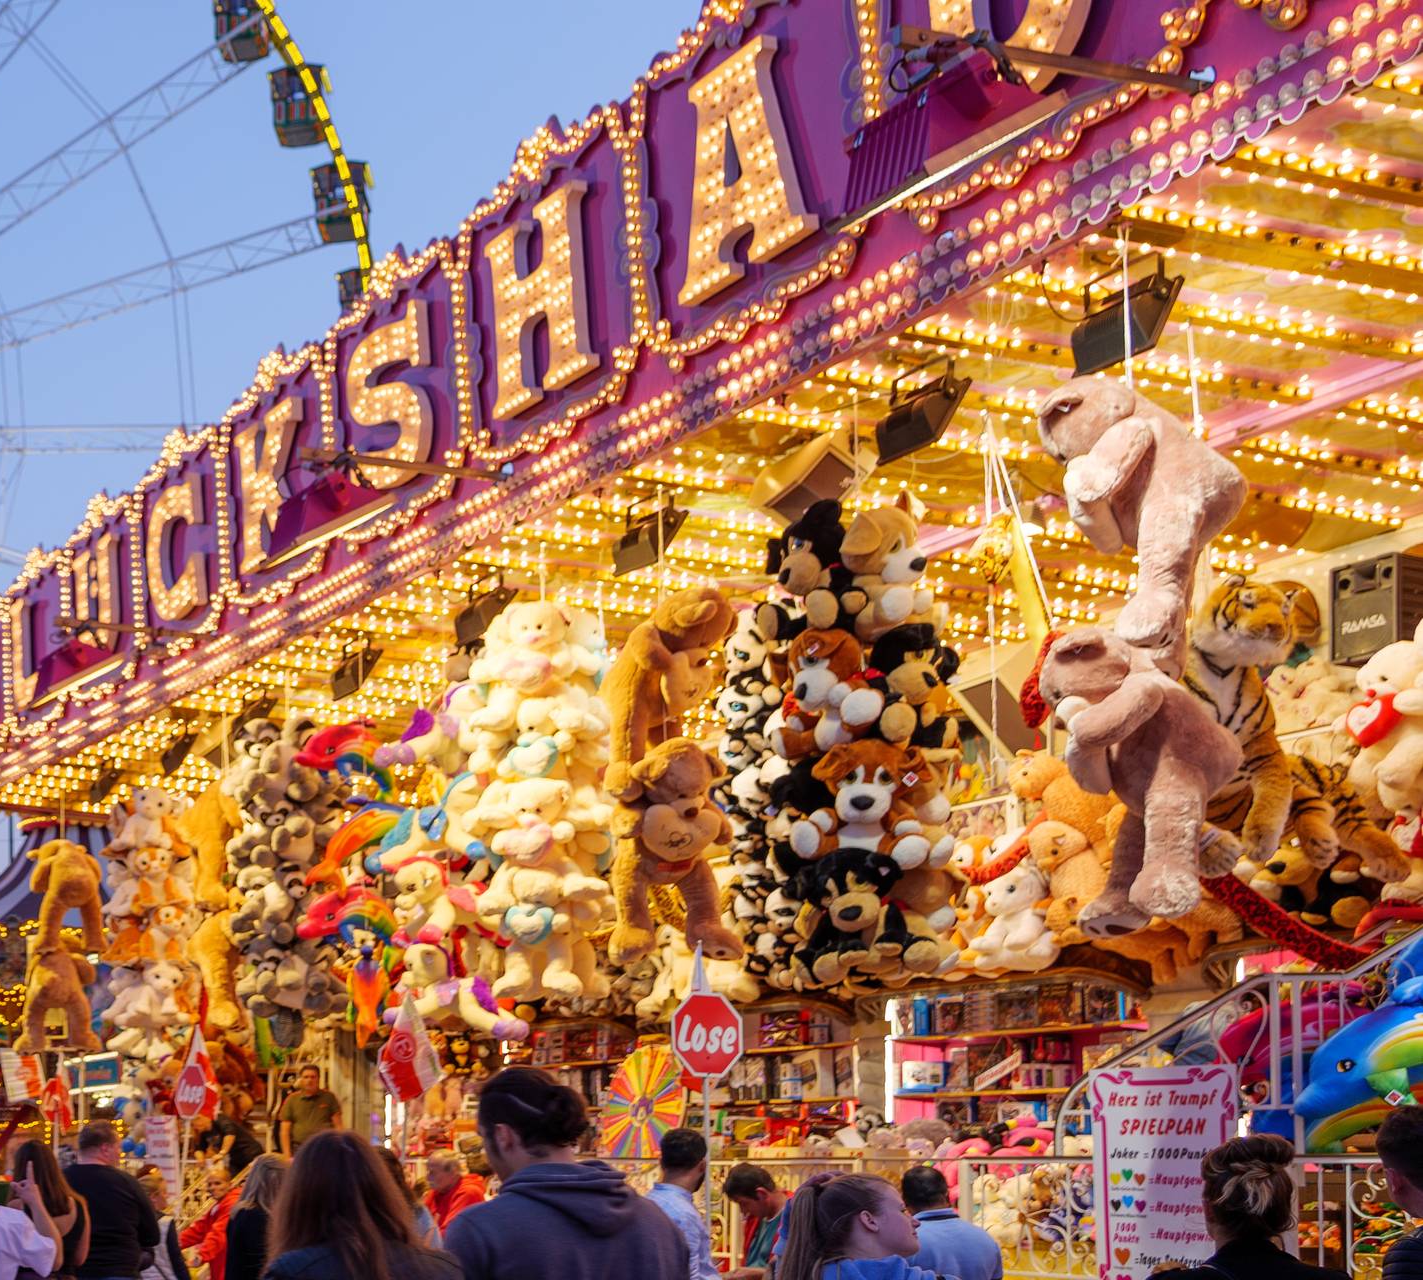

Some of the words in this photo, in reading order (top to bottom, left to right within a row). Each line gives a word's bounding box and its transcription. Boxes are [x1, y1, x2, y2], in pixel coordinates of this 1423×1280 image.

[1342, 614, 1386, 635] RAMSA
[678, 1014, 737, 1054] Lose
[177, 1078, 203, 1104] Lose
[1108, 1092, 1138, 1106] Herz
[1144, 1089, 1163, 1106] ist
[1168, 1089, 1217, 1109] Trumpf
[1119, 1118, 1207, 1136] SPIELPLAN
[1110, 1147, 1139, 1159] Joker
[1115, 1222, 1137, 1233] 1000
